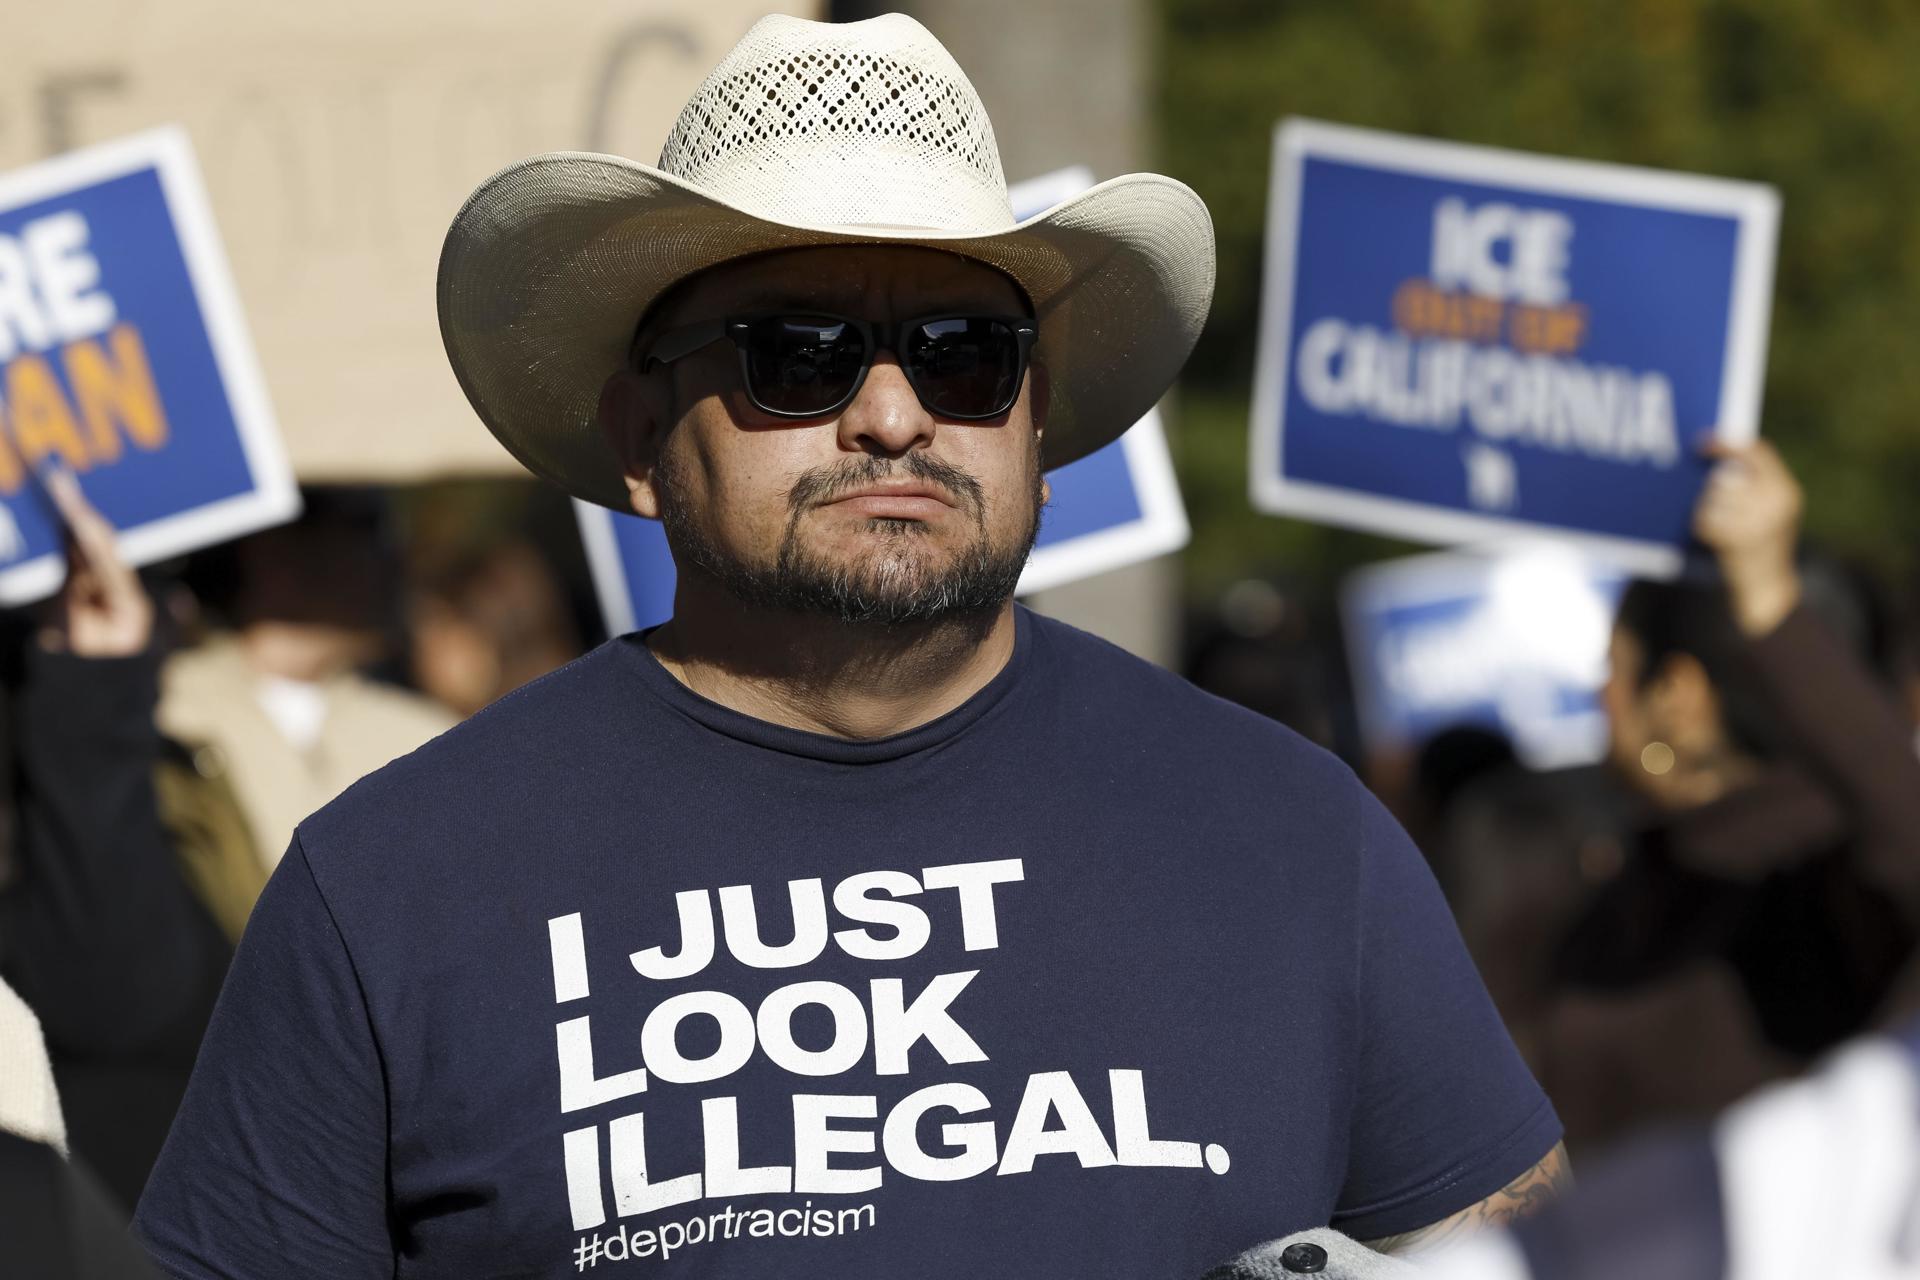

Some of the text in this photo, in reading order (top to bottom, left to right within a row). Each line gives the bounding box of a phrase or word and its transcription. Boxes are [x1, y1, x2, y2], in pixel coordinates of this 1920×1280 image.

[1431, 197, 1573, 307] ICE
[1297, 318, 1679, 468] CALIFORNIA
[548, 859, 1025, 1003] I JUST
[556, 970, 990, 1113] LOOK
[564, 1069, 1231, 1231] ILLEGAL.
[574, 1201, 876, 1272] #deportracism
